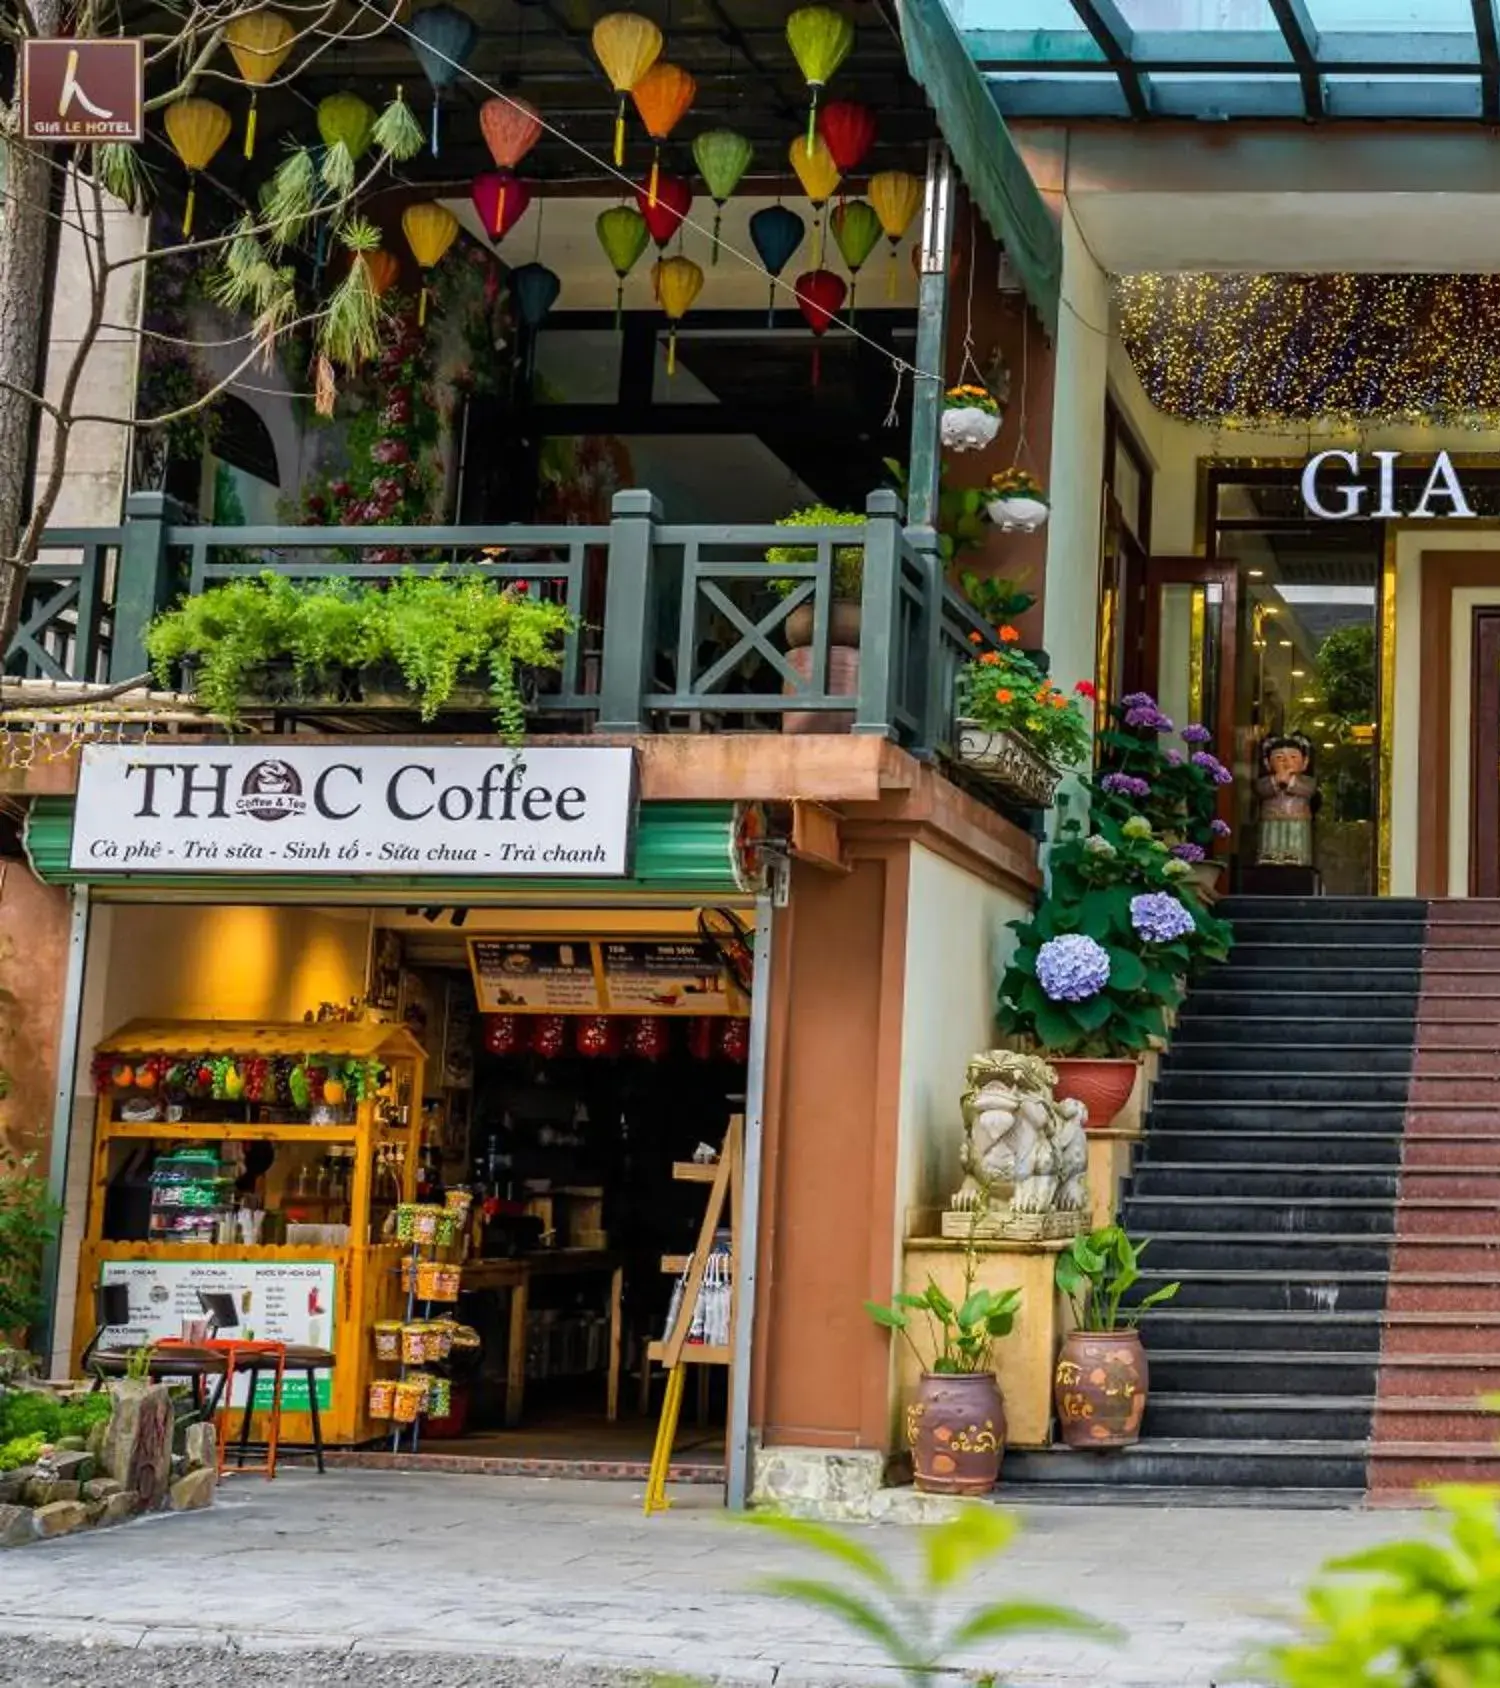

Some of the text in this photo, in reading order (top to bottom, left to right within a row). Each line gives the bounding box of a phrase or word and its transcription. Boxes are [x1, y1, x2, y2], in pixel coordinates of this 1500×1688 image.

[33, 121, 133, 134] GIA LE HOTEL
[1301, 449, 1477, 520] GIA
[235, 797, 273, 808] Coffee
[288, 798, 306, 809] Tea
[385, 763, 587, 822] Coffee
[89, 839, 119, 859] Cà
[122, 839, 162, 862] phê
[283, 841, 330, 860] Sinh
[427, 842, 477, 862] chua
[542, 843, 607, 862] chanh
